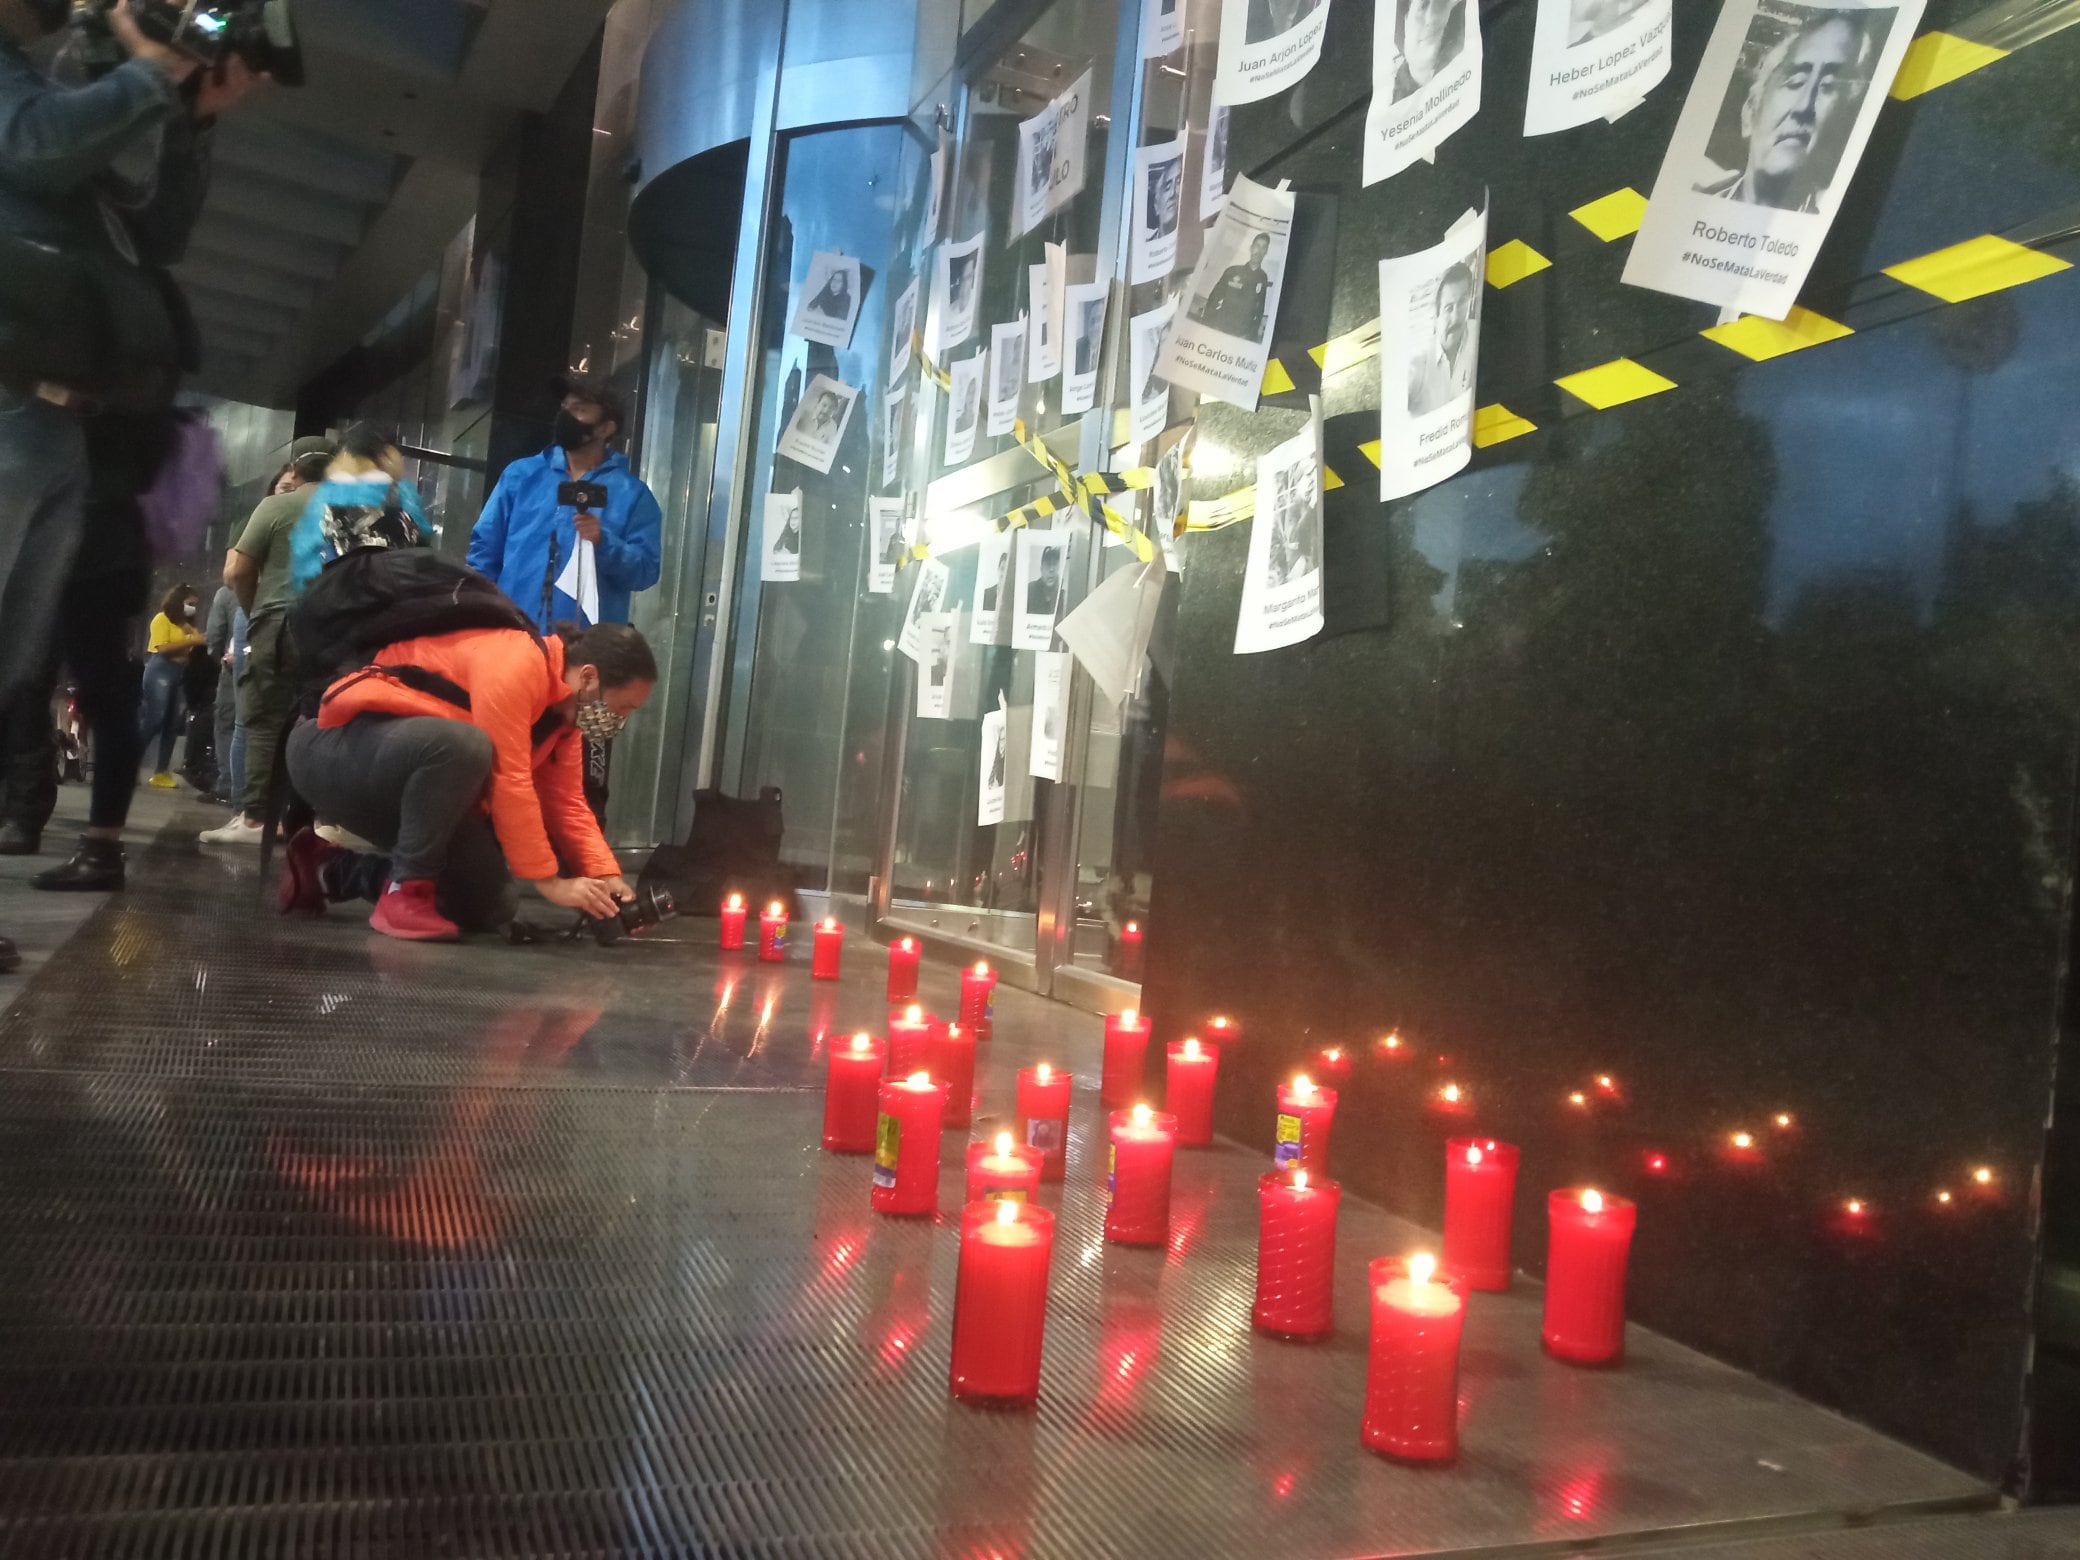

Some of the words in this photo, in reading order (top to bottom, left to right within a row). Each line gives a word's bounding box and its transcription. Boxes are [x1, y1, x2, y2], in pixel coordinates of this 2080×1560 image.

[1238, 58, 1266, 73] Juan
[1549, 63, 1596, 87] Heber
[1380, 110, 1424, 142] Yesenia
[1424, 69, 1472, 114] Mollinedo
[1692, 220, 1758, 249] Roberto
[1760, 235, 1800, 258] Toledo
[1681, 250, 1790, 285] #NoSeMataLaVerdad
[1175, 334, 1195, 351] Juan
[1197, 343, 1235, 366] Carlos
